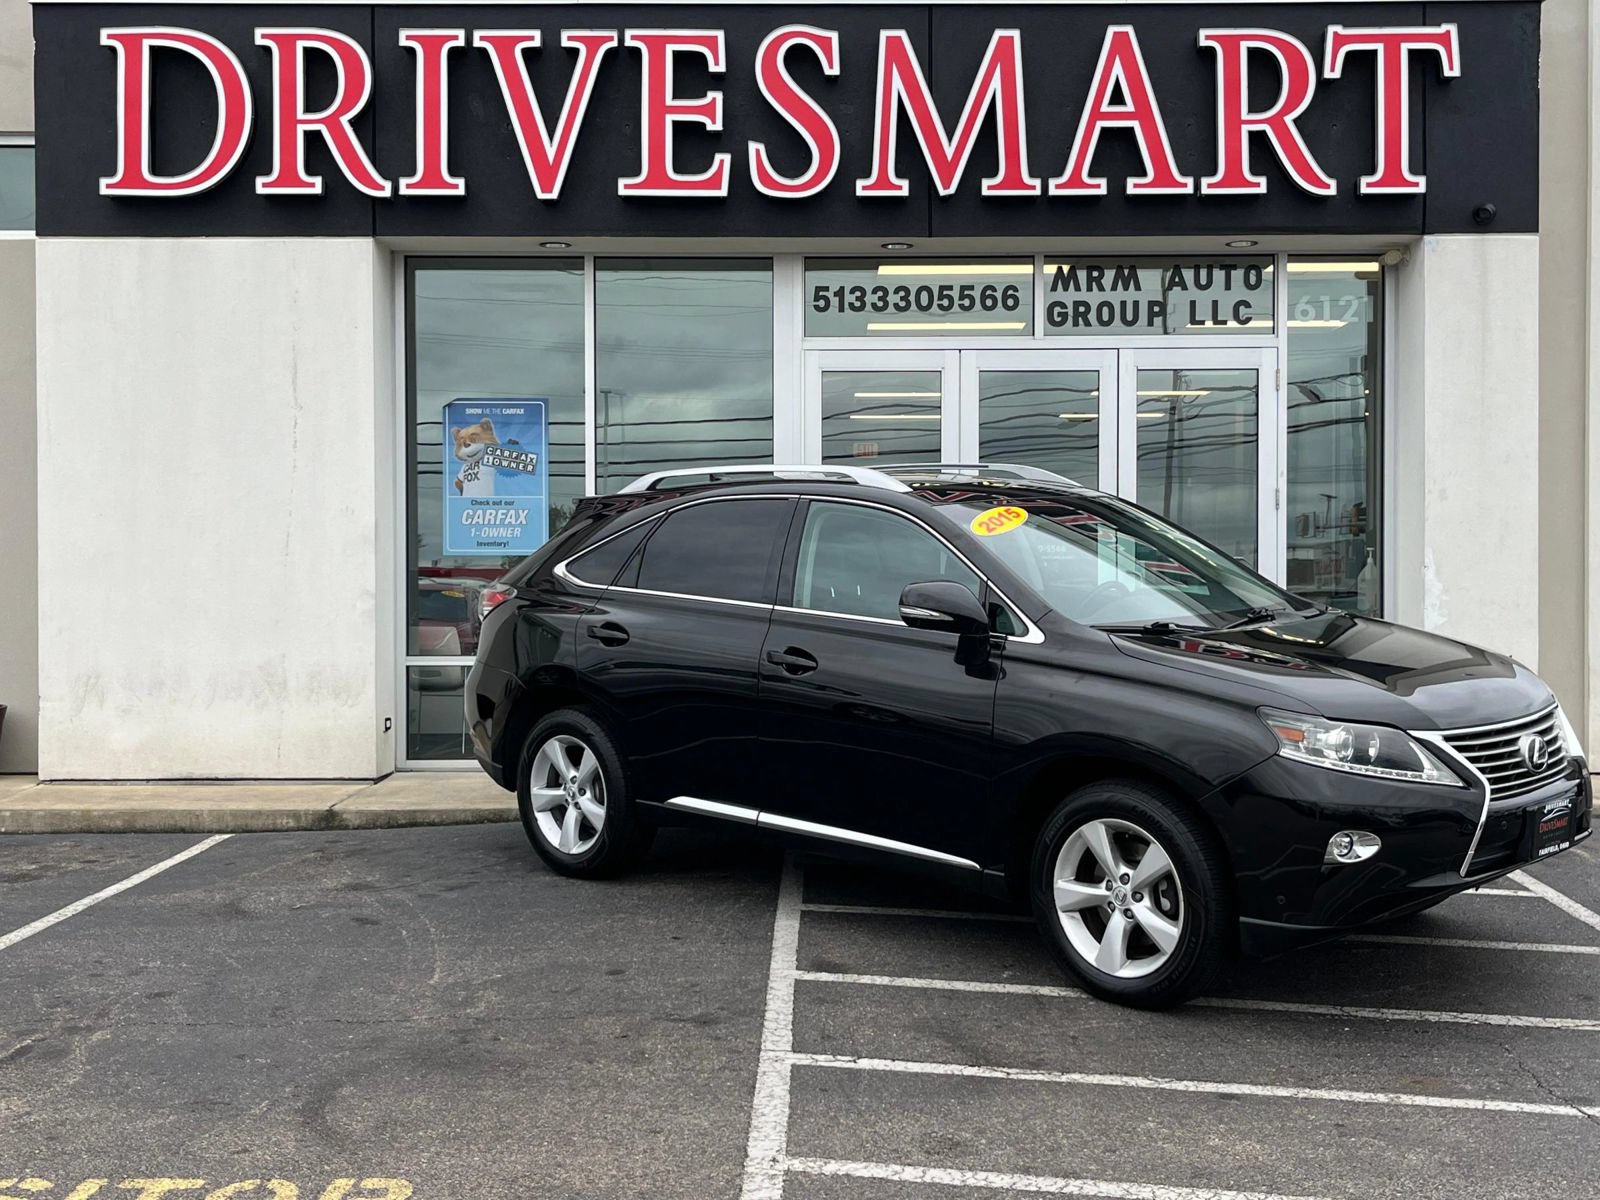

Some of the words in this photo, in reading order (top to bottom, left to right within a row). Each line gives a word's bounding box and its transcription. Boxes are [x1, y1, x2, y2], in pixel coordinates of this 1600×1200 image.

[99, 24, 1461, 200] DRIVESMART
[1050, 264, 1142, 292] MRM
[1166, 264, 1263, 291] AUTO
[812, 284, 1020, 313] 5133305566
[1046, 300, 1167, 327] GROUP
[1189, 299, 1253, 326] LLC
[486, 446, 537, 463] CARFAX
[463, 461, 480, 473] CAR
[494, 459, 535, 472] OWNER
[463, 471, 480, 483] FOX
[462, 509, 529, 525] CARFAX
[978, 508, 1021, 533] 2015
[470, 527, 521, 538] 1-OWNER
[476, 540, 510, 548] Inventory!
